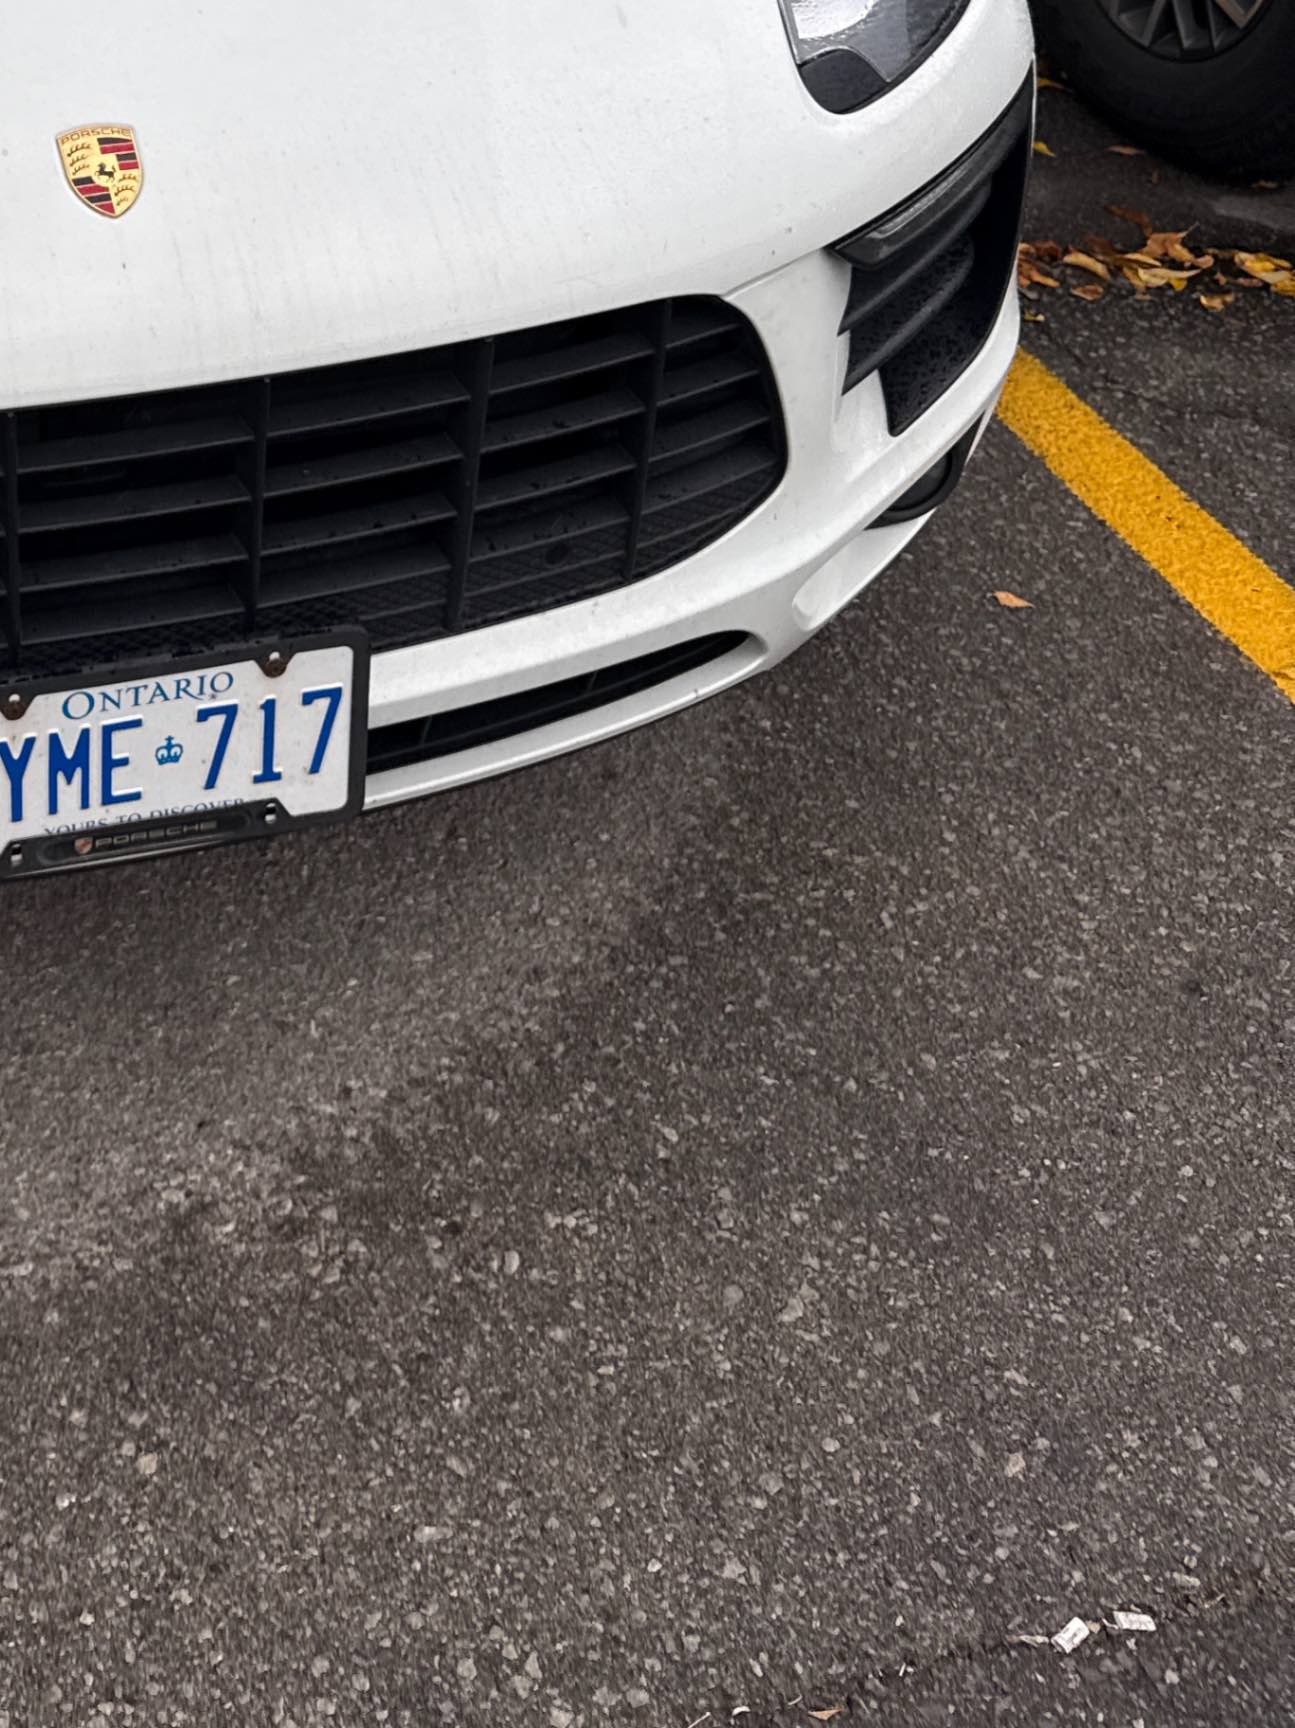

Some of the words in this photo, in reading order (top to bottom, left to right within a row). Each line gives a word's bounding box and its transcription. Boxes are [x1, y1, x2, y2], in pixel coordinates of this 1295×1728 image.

[61, 128, 132, 144] PORSCHE
[62, 671, 234, 719] ONTARIO
[196, 681, 343, 791] 717
[95, 821, 218, 849] PORSCHE
